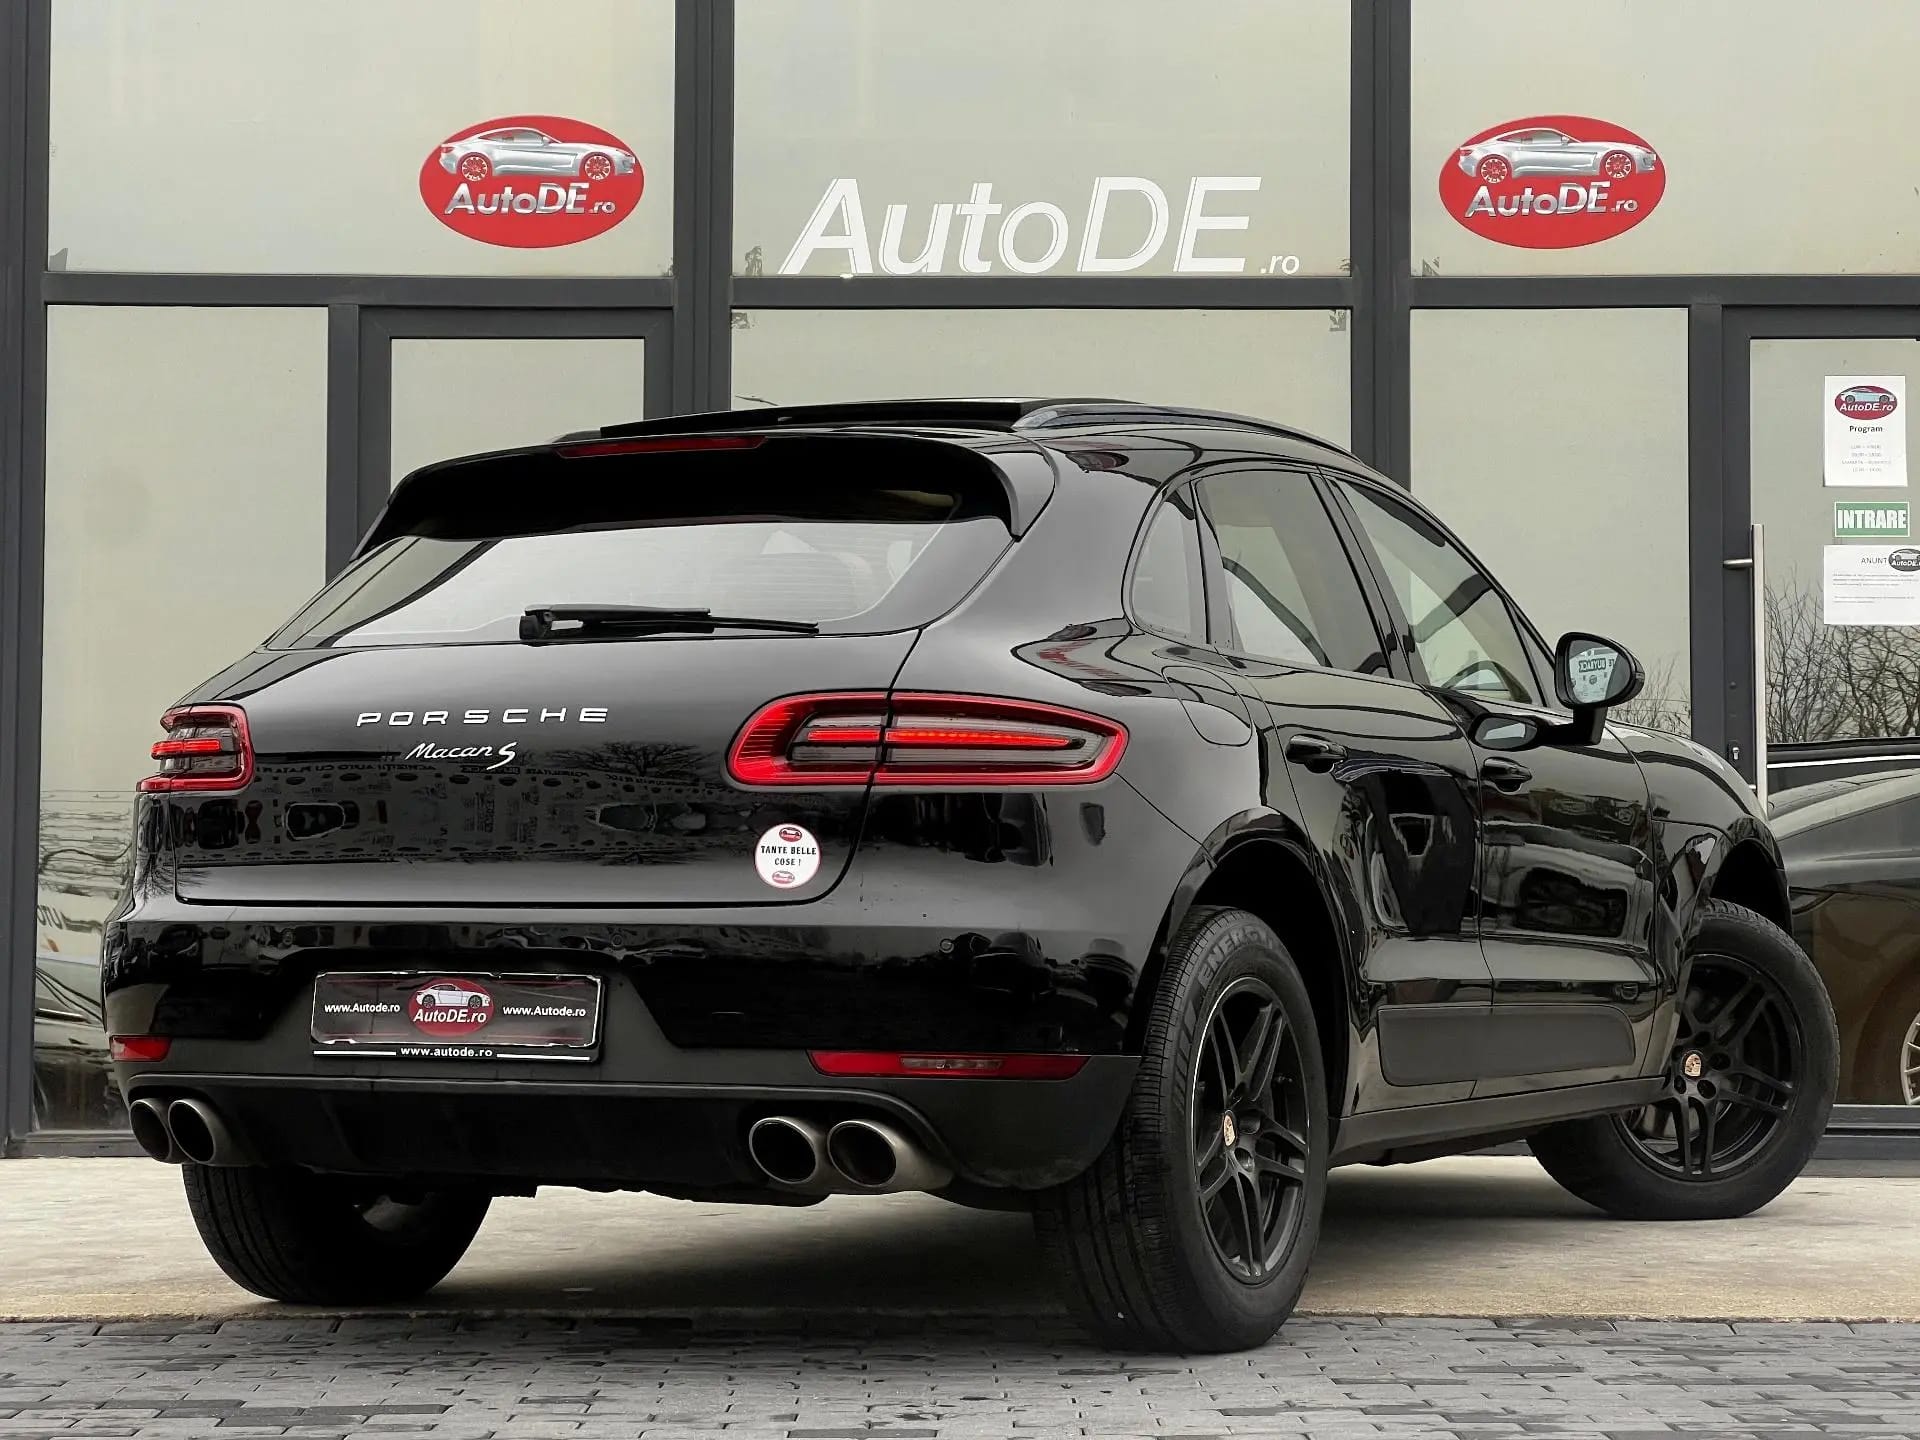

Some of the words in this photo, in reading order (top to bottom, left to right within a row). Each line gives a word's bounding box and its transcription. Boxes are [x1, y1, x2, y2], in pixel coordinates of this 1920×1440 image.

[1839, 403, 1894, 412] AutoDE.ro
[1849, 425, 1883, 433] Program
[1837, 509, 1907, 529] INTRARE
[356, 707, 608, 727] PORSCHE
[404, 742, 493, 761] Macan
[487, 742, 518, 771] S
[761, 846, 787, 854] TANTE
[791, 847, 816, 855] BELLE
[324, 1002, 401, 1014] www.Autode.ro
[502, 1005, 586, 1018] www.Autode.ro
[413, 1008, 487, 1023] AutoDE.ro
[400, 1046, 493, 1058] www.autode.ro
